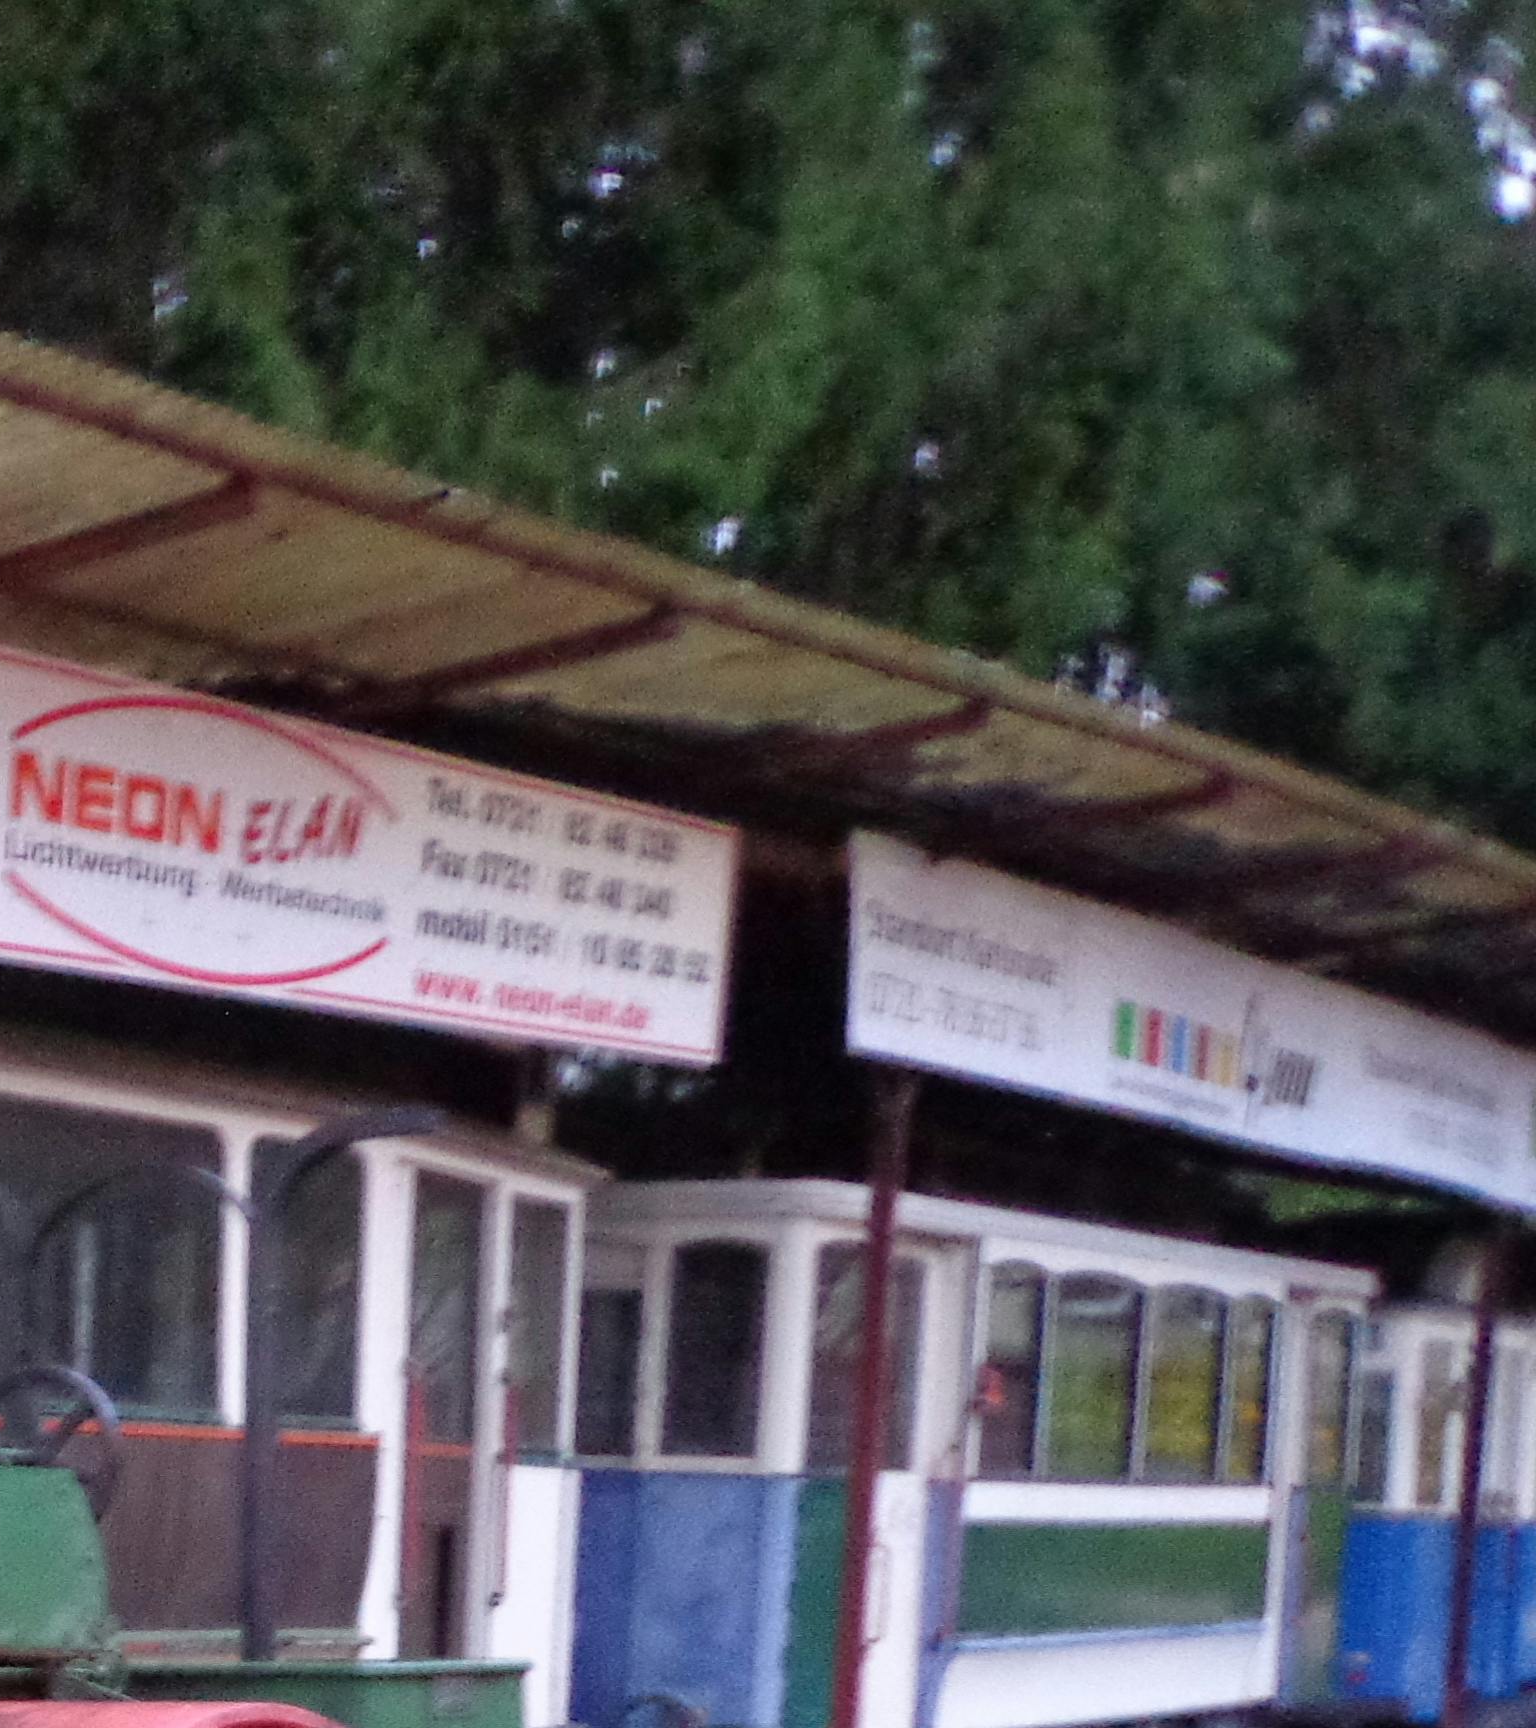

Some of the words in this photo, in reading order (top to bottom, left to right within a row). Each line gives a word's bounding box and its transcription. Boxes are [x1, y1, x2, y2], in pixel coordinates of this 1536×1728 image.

[8, 747, 224, 855] NEON
[240, 788, 368, 866] ELAN
[3, 828, 199, 900] Lichtwerbung
[421, 838, 469, 879] Fax
[415, 908, 490, 946] mobil
